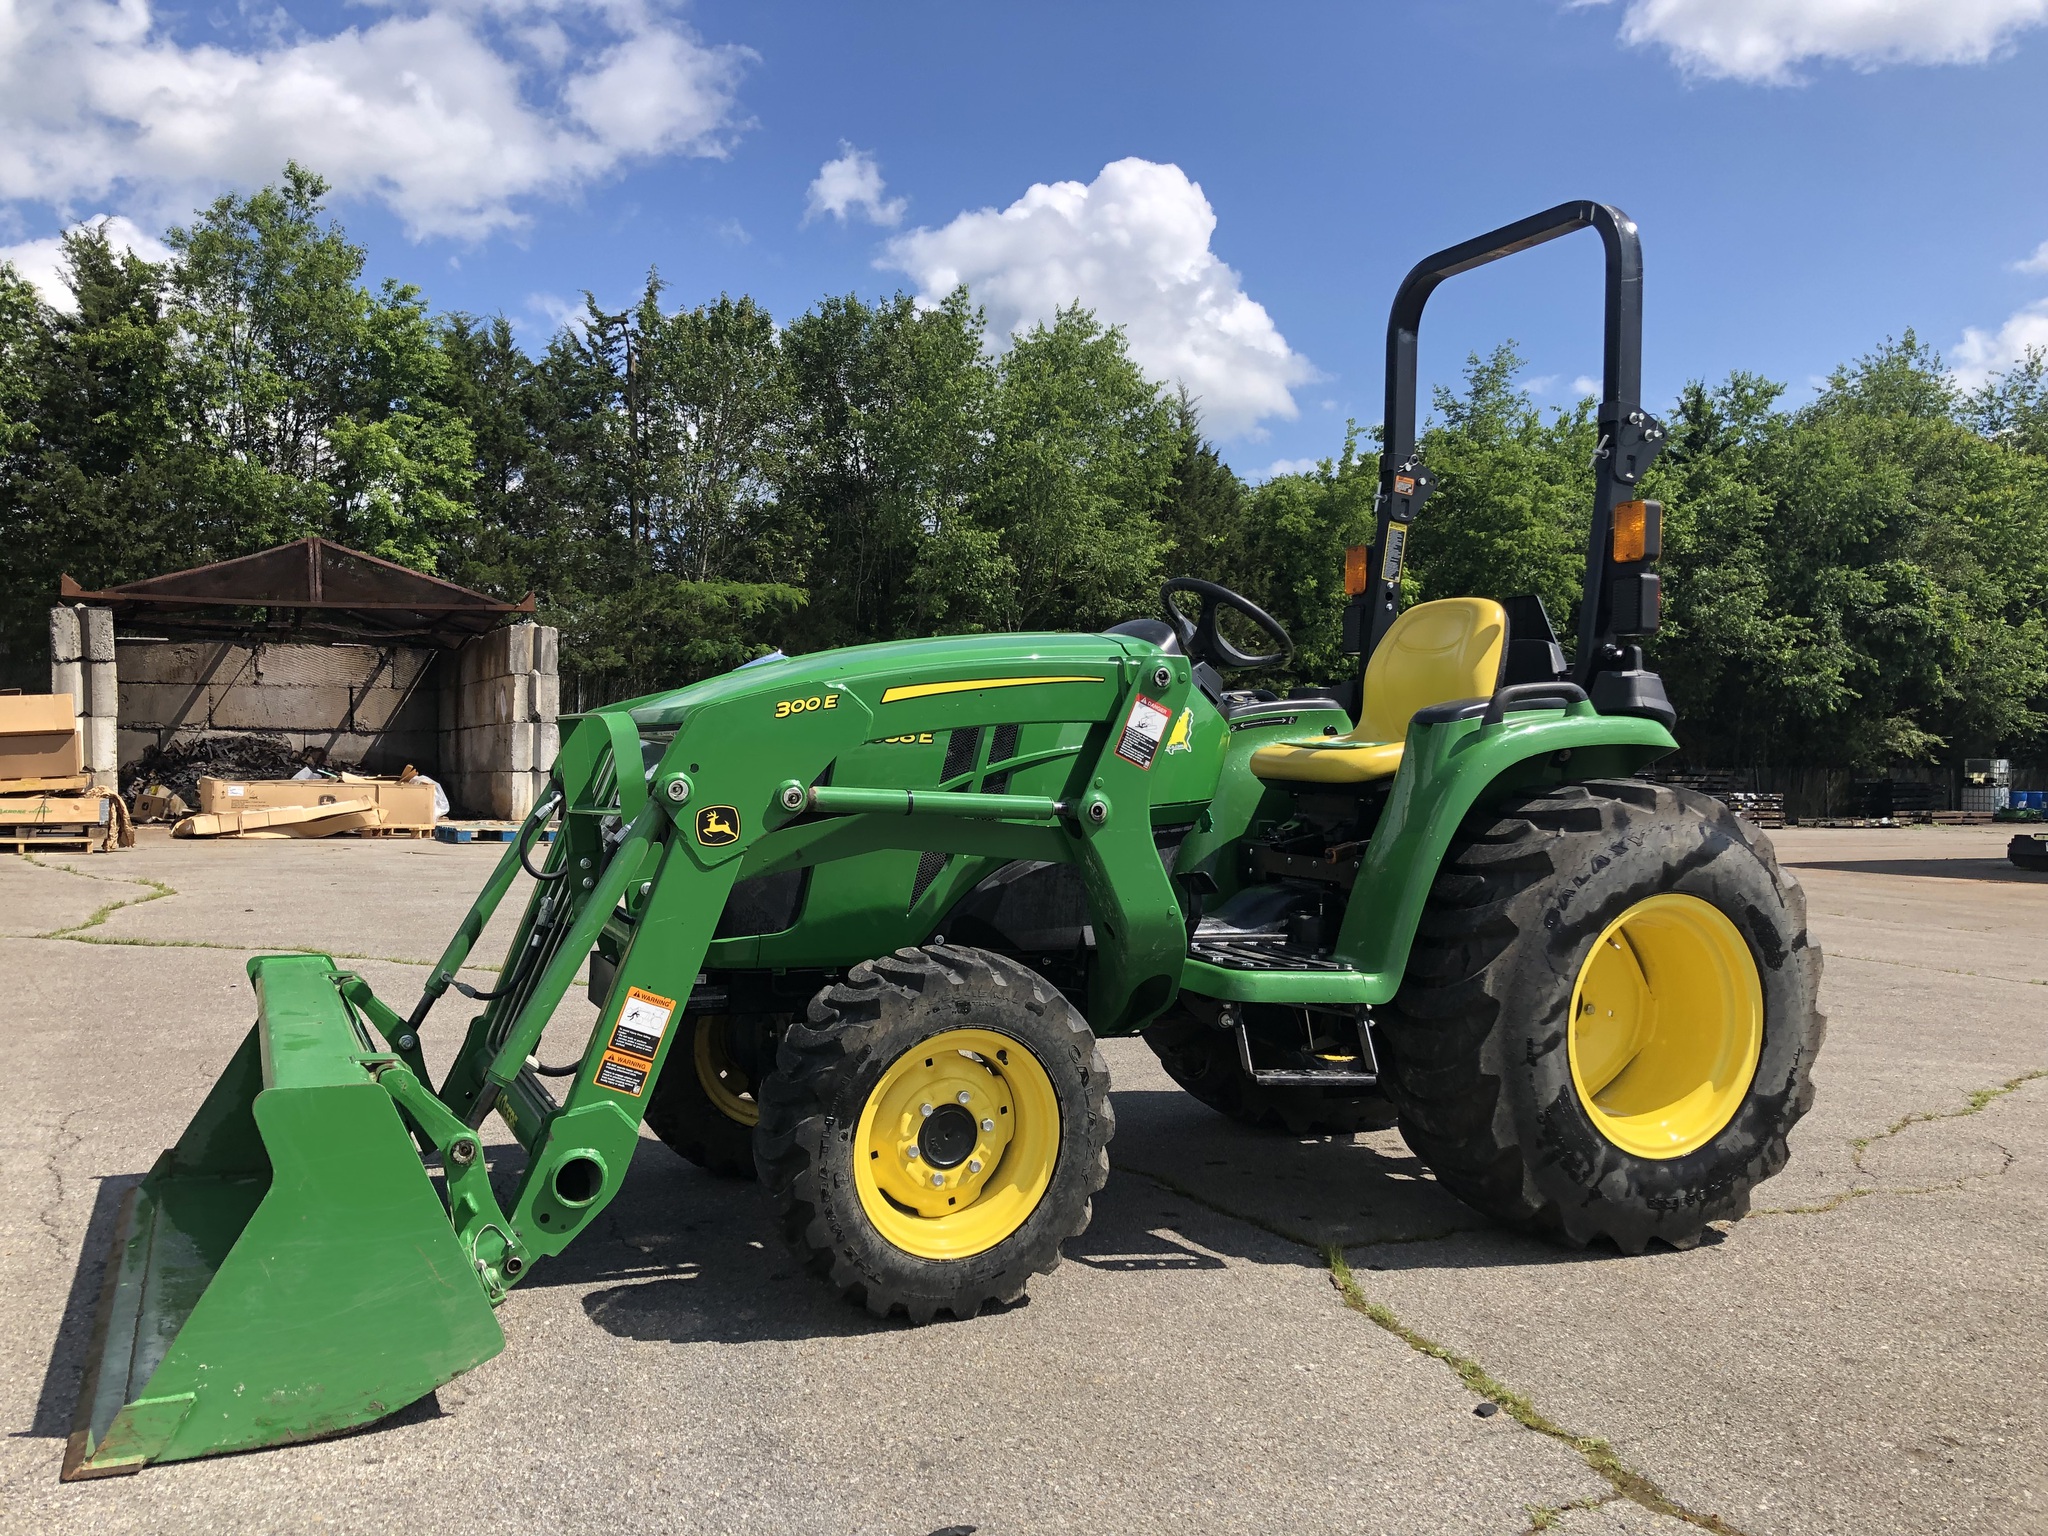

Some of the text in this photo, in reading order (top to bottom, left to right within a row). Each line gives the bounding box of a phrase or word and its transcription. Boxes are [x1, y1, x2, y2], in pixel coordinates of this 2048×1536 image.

[1147, 701, 1168, 715] DANGER
[1544, 832, 1645, 929] GALAXY
[641, 993, 670, 1007] WARNING
[617, 1056, 647, 1070] WARNING
[1068, 1044, 1097, 1185] GALAXY
